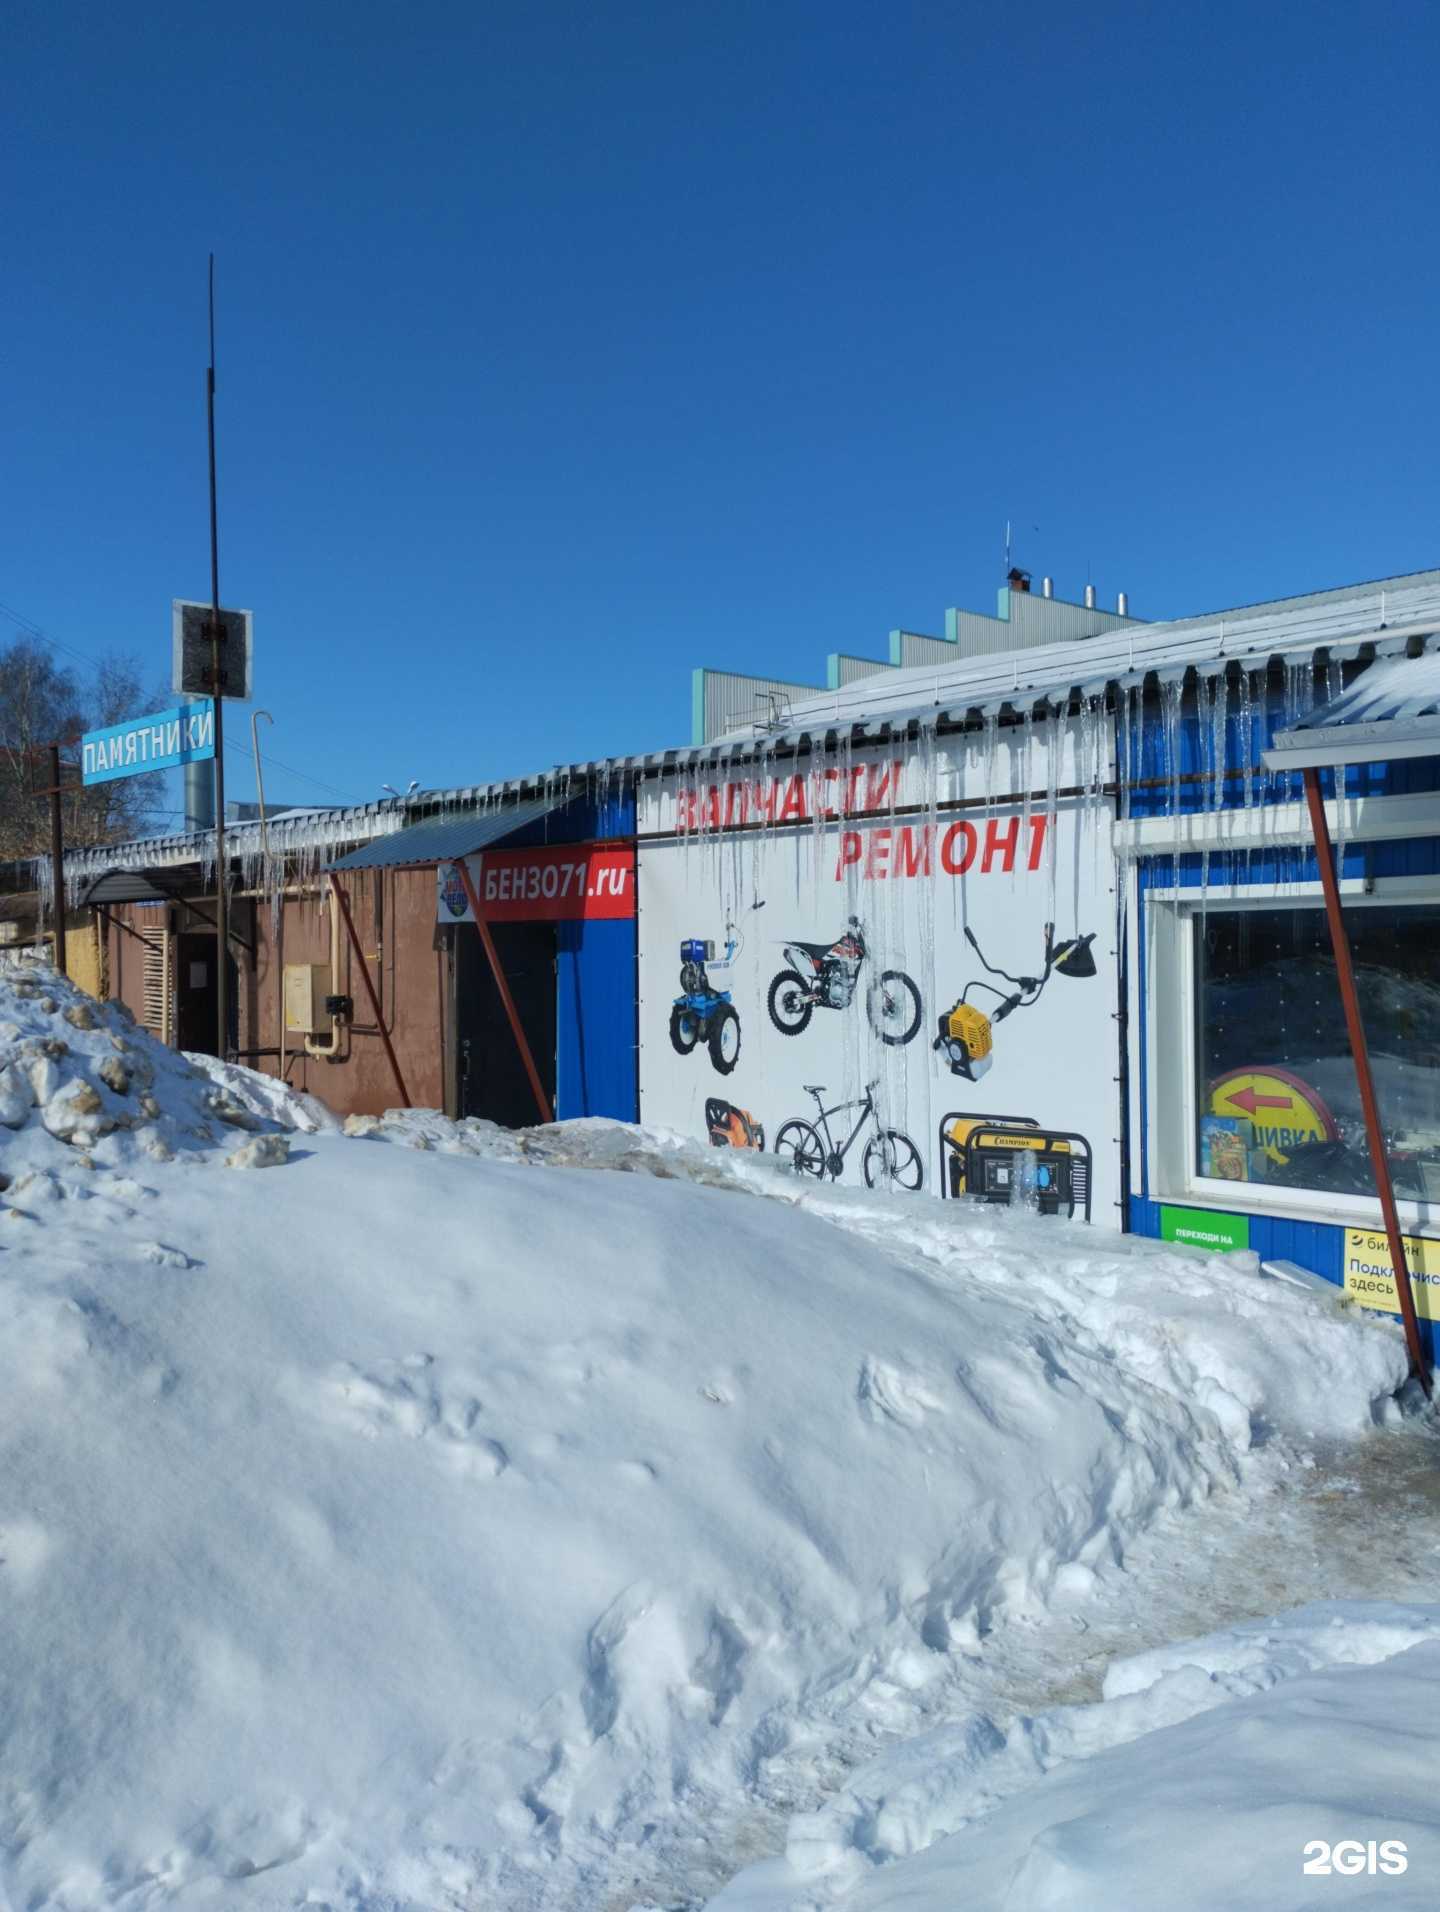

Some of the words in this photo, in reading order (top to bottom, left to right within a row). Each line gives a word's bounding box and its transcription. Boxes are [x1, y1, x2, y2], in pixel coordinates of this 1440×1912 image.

[82, 711, 213, 775] ПАМЯТНИКИ
[675, 760, 904, 832] ЗАПЧАСТИ
[835, 813, 1057, 882] РЕМОНТ
[1175, 1228, 1219, 1243] ПЕРЕХОДИ
[1220, 1234, 1233, 1245] НА
[1367, 1237, 1419, 1256] бийн
[1350, 1259, 1440, 1285] Подклчис
[1350, 1278, 1394, 1294] здесь
